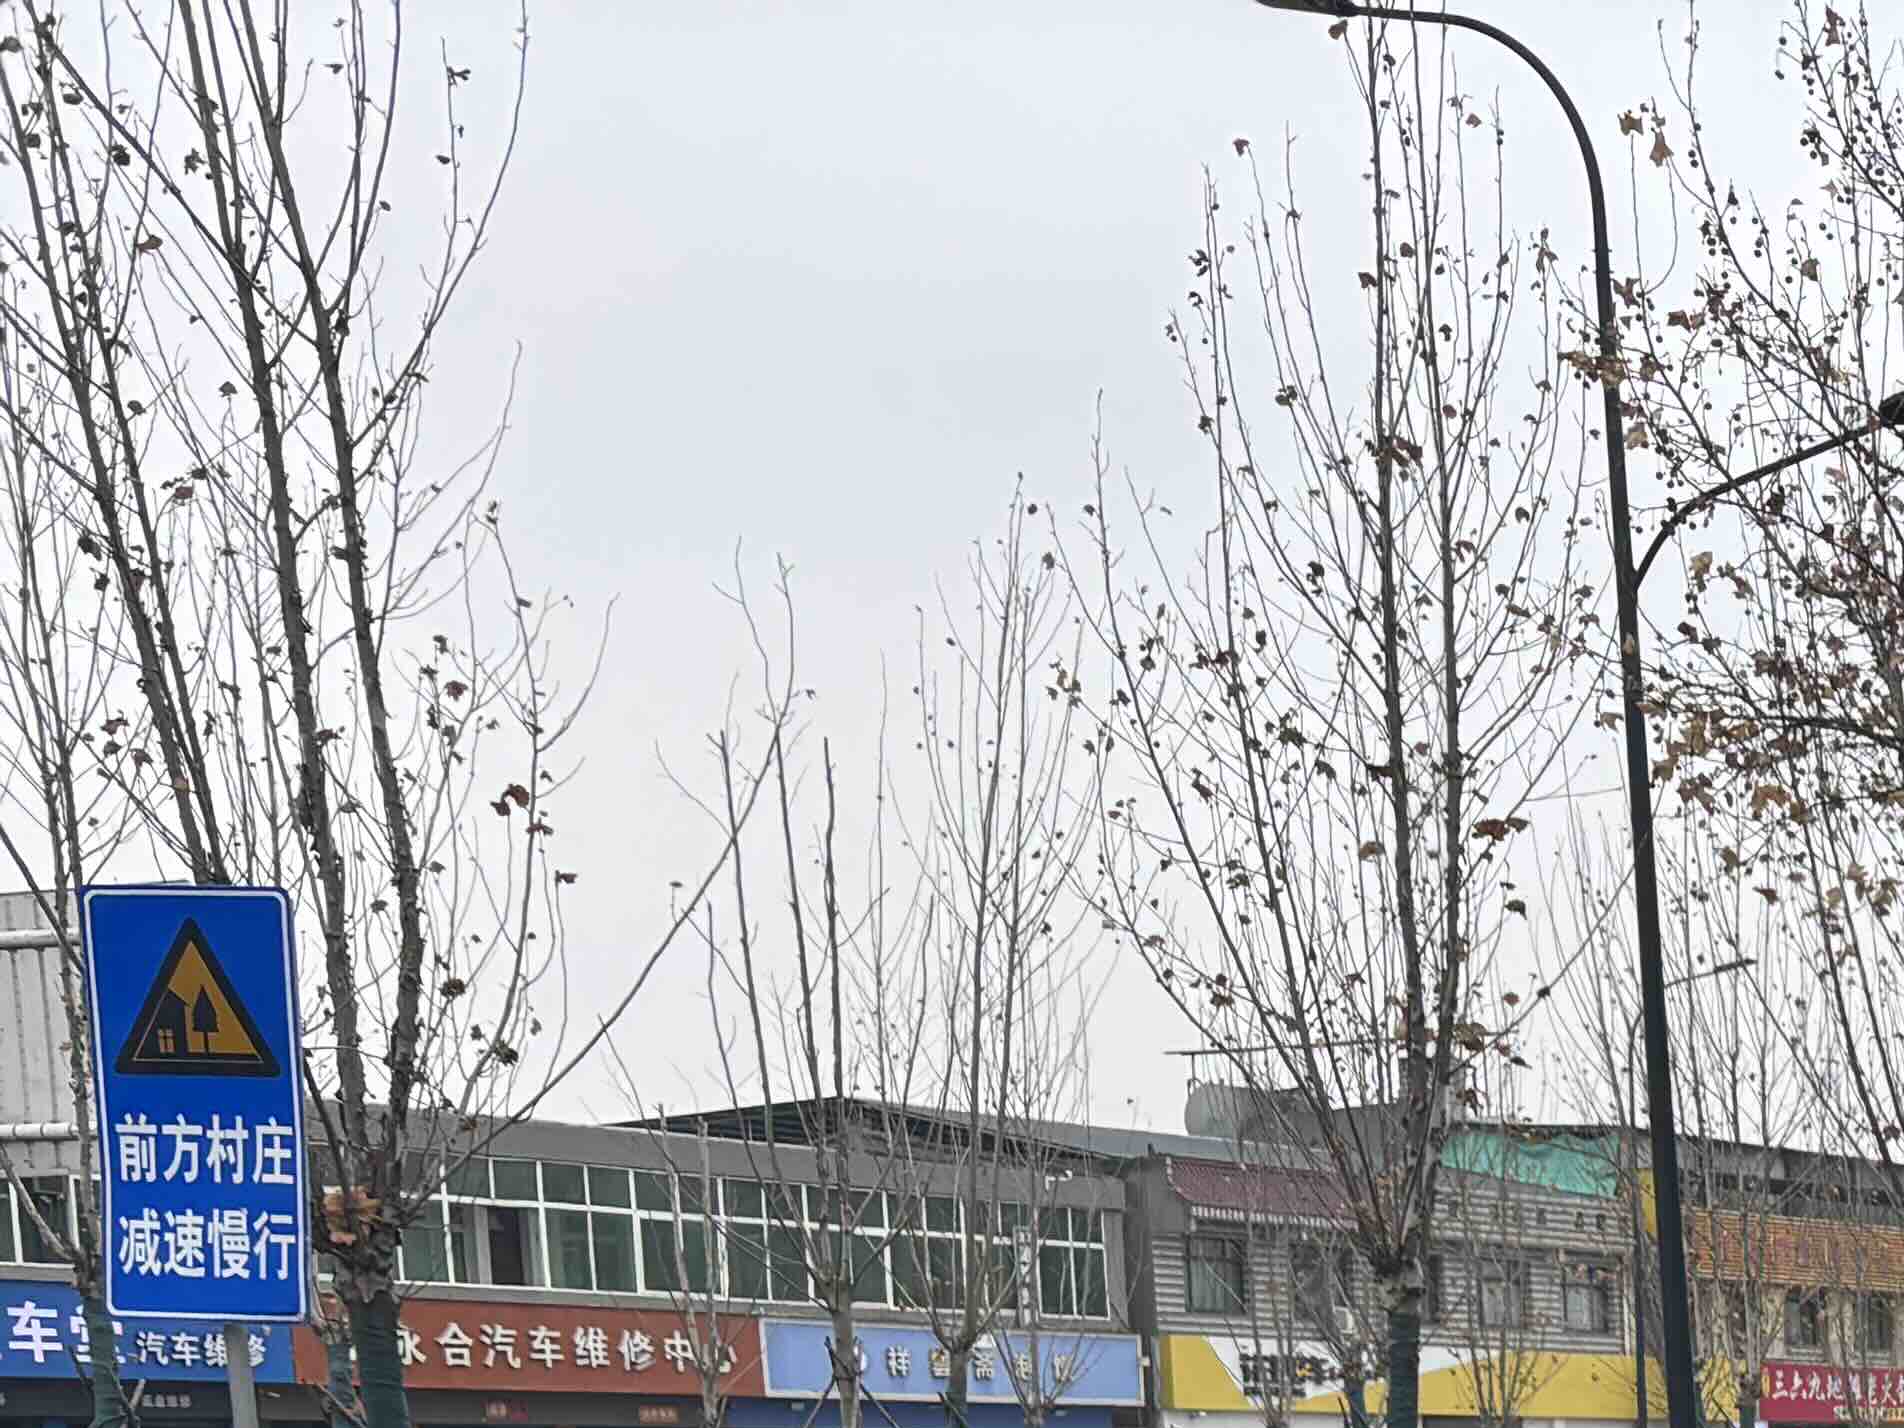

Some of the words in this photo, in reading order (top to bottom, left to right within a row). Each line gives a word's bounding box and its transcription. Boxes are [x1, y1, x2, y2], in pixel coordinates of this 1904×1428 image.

[115, 1114, 294, 1185] 前方村庄
[118, 1206, 296, 1281] 减速慢行
